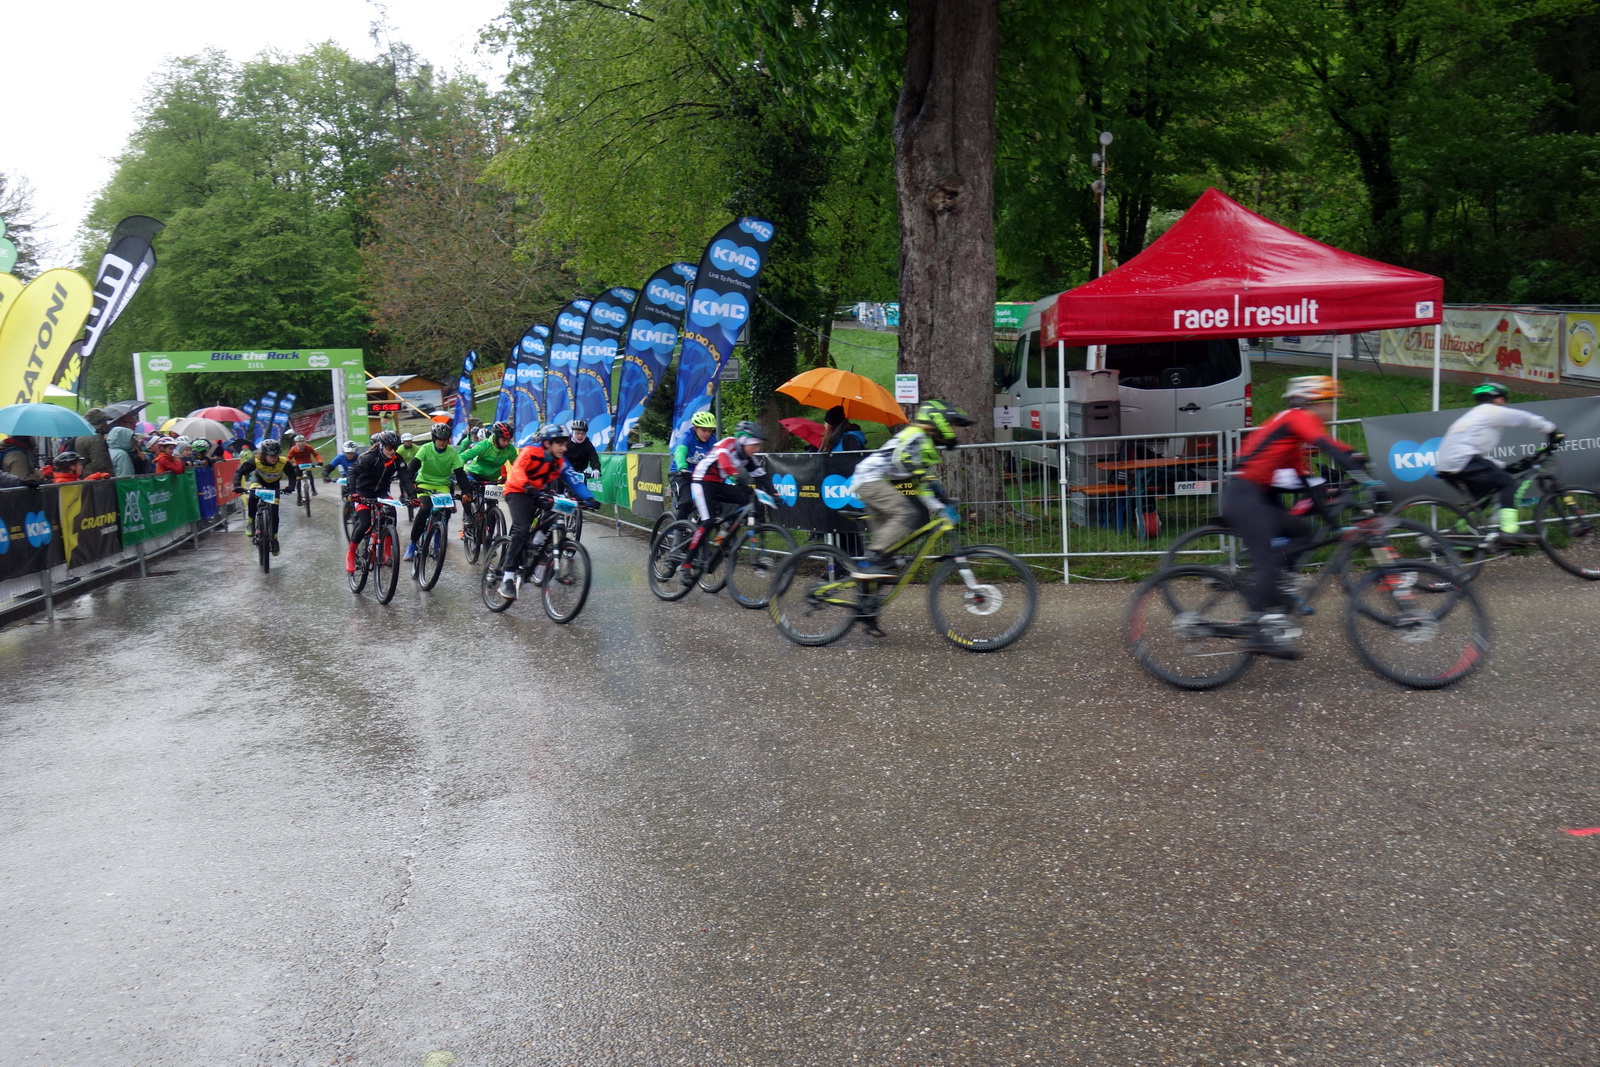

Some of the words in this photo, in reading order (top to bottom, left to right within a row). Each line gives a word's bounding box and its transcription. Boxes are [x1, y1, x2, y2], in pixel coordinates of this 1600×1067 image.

[713, 246, 758, 271] KMC
[708, 271, 720, 279] Link
[727, 277, 751, 289] Perfection
[649, 285, 686, 306] KMC
[593, 307, 625, 323] KMC
[692, 299, 746, 320] KMC
[1173, 308, 1228, 329] race
[1244, 298, 1319, 326] result
[631, 328, 675, 345] KMC
[523, 340, 545, 352] KMC
[581, 345, 618, 357] KMC
[550, 350, 580, 360] KMC
[517, 368, 542, 378] KMC
[1394, 451, 1438, 469] KM
[1486, 448, 1515, 460] LINK
[1519, 443, 1536, 455] TO
[637, 481, 663, 494] CRATONI
[824, 485, 859, 498] KM
